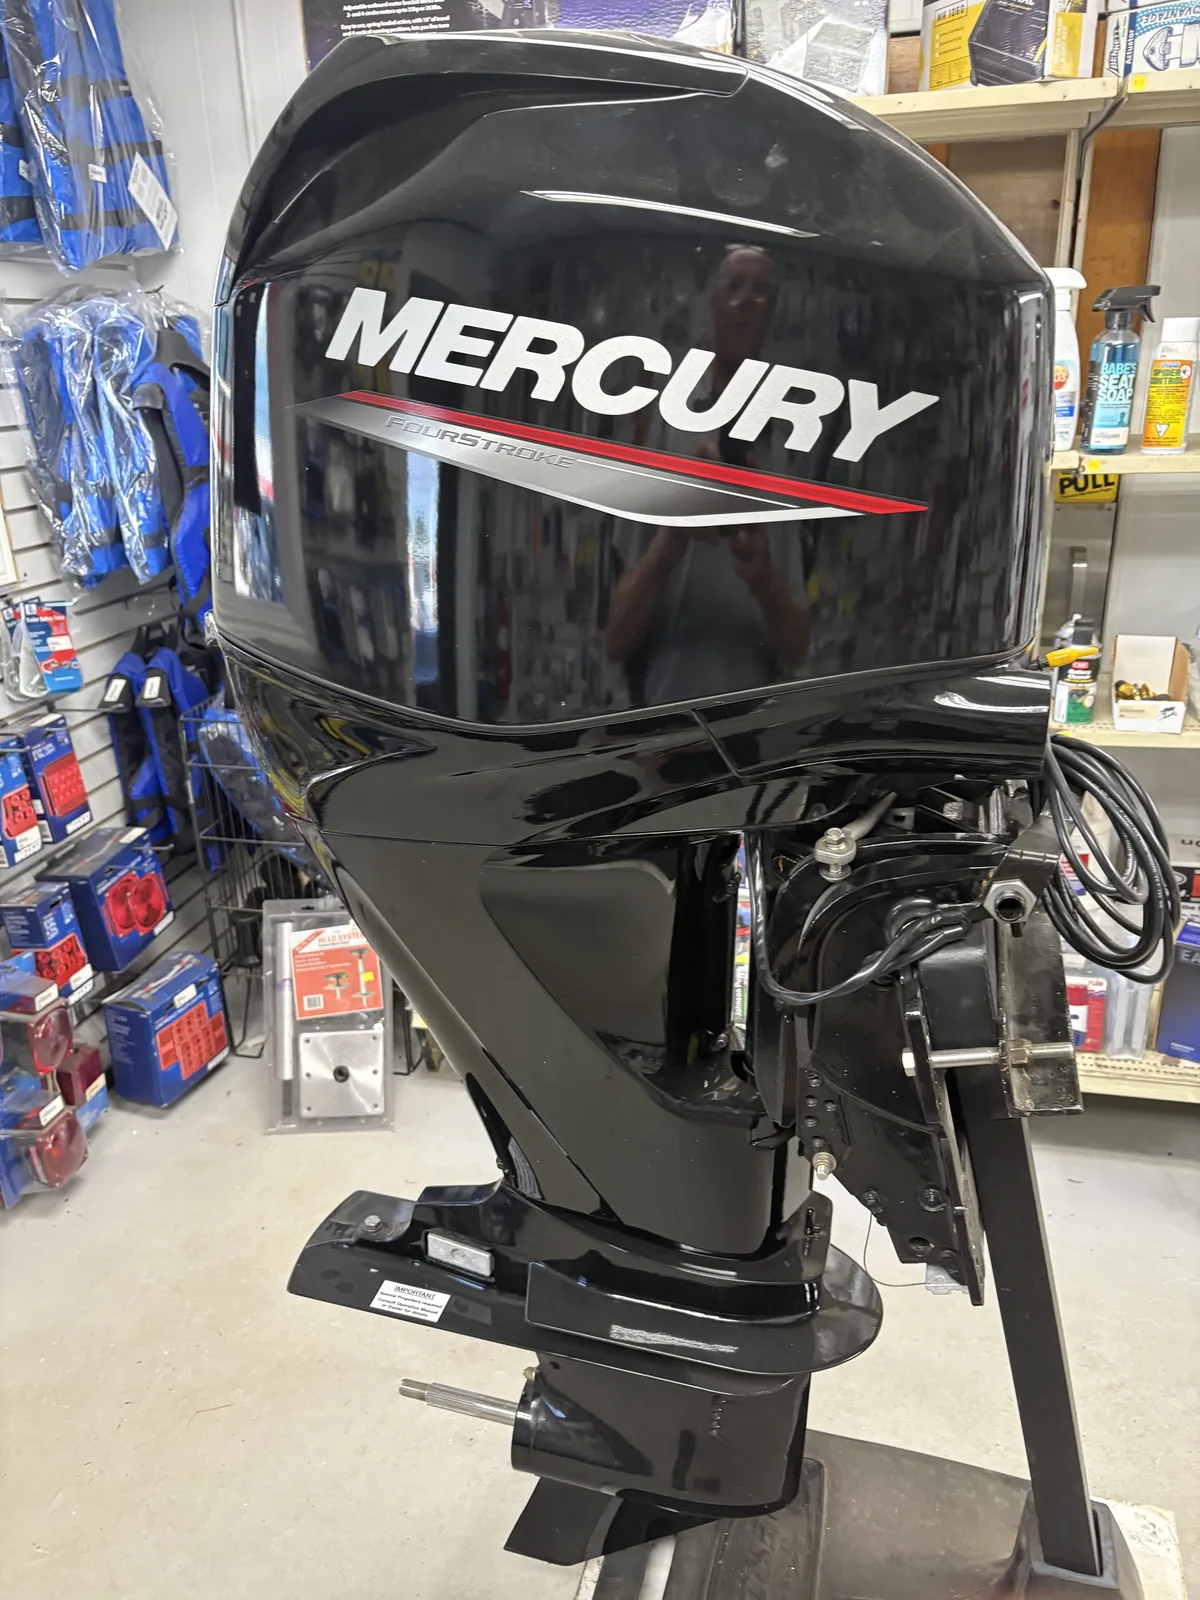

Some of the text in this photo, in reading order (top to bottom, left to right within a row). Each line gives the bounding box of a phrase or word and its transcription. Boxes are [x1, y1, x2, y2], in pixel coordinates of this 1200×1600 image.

[1141, 6, 1200, 24] DVANTAGE
[1125, 30, 1135, 64] Actuator
[324, 286, 941, 463] MERCURY
[1099, 373, 1136, 391] SEAT
[1096, 388, 1133, 403] SOAP
[385, 414, 578, 469] FOURSTROKE
[1059, 473, 1116, 495] PULL
[339, 931, 364, 942] SYSTE
[394, 1285, 436, 1299] IMPORTANT
[377, 1297, 438, 1315] Consult Operation Manual
[397, 1295, 421, 1304] Propellers
[421, 1301, 443, 1309] required
